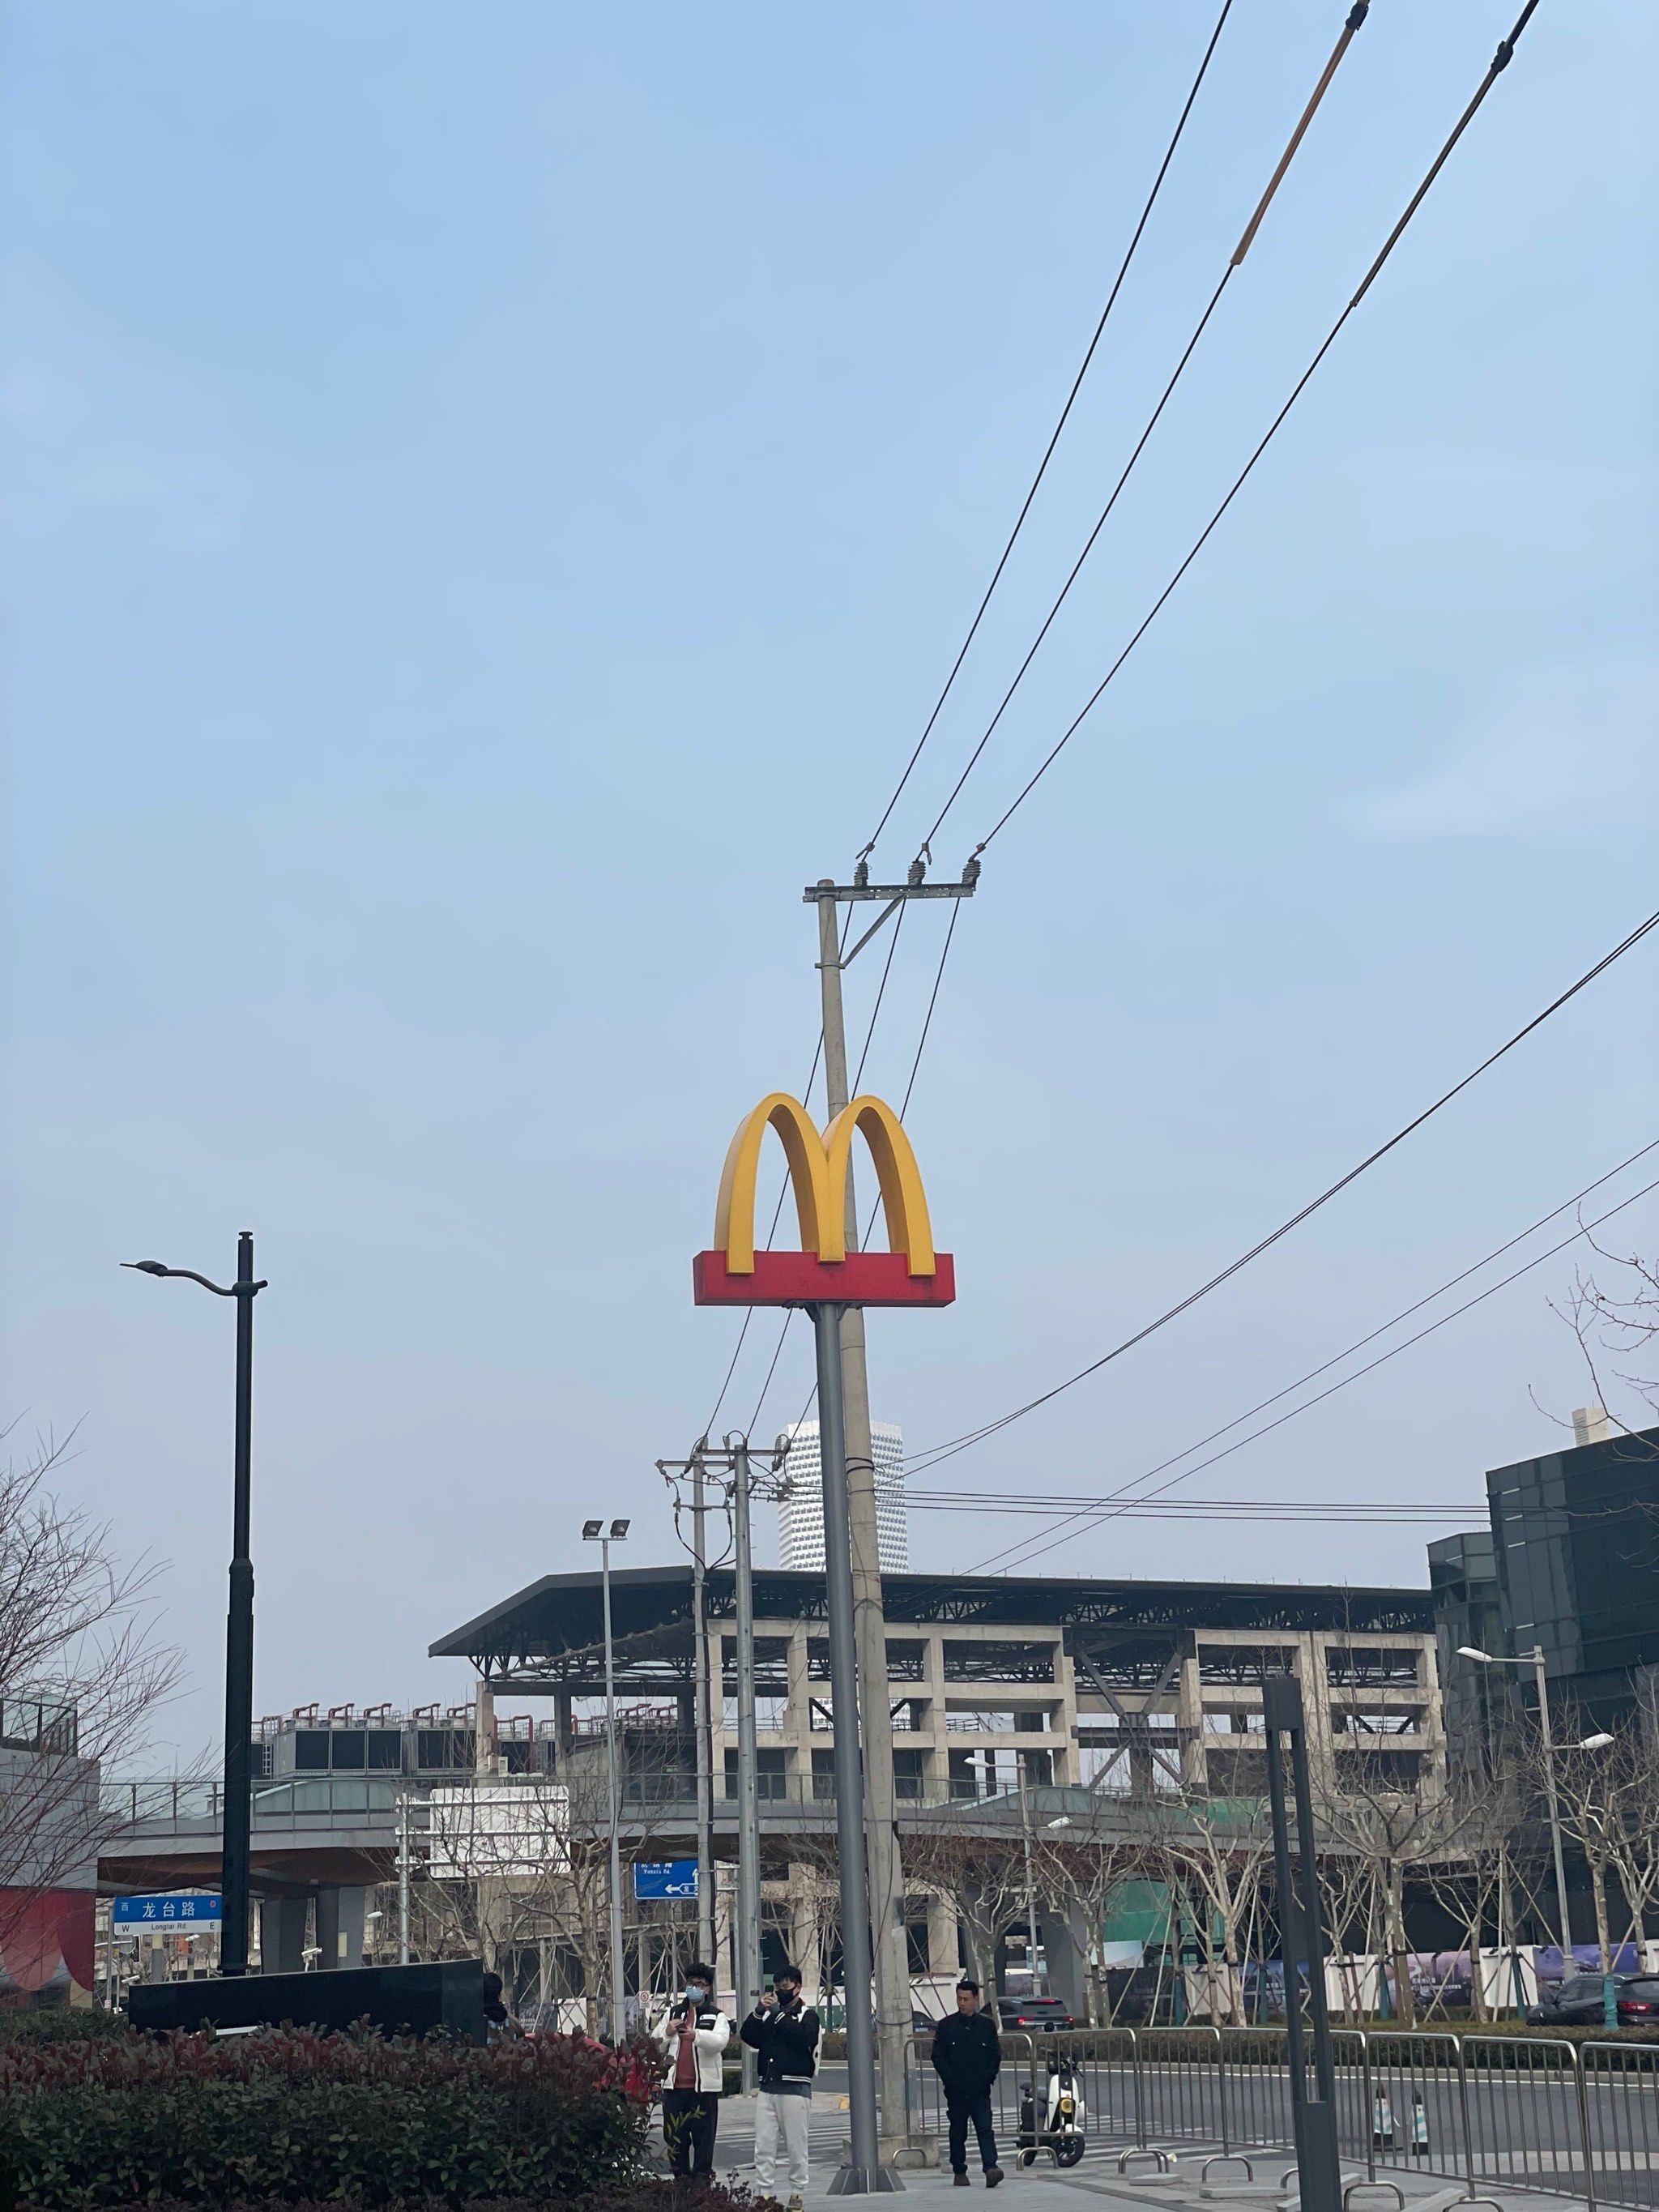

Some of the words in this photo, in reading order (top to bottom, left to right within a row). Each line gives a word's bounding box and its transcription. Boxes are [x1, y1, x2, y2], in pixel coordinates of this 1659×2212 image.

[121, 1902, 129, 1911] 西
[142, 1901, 195, 1918] 龙台路
[151, 1923, 175, 1931] Longtai
